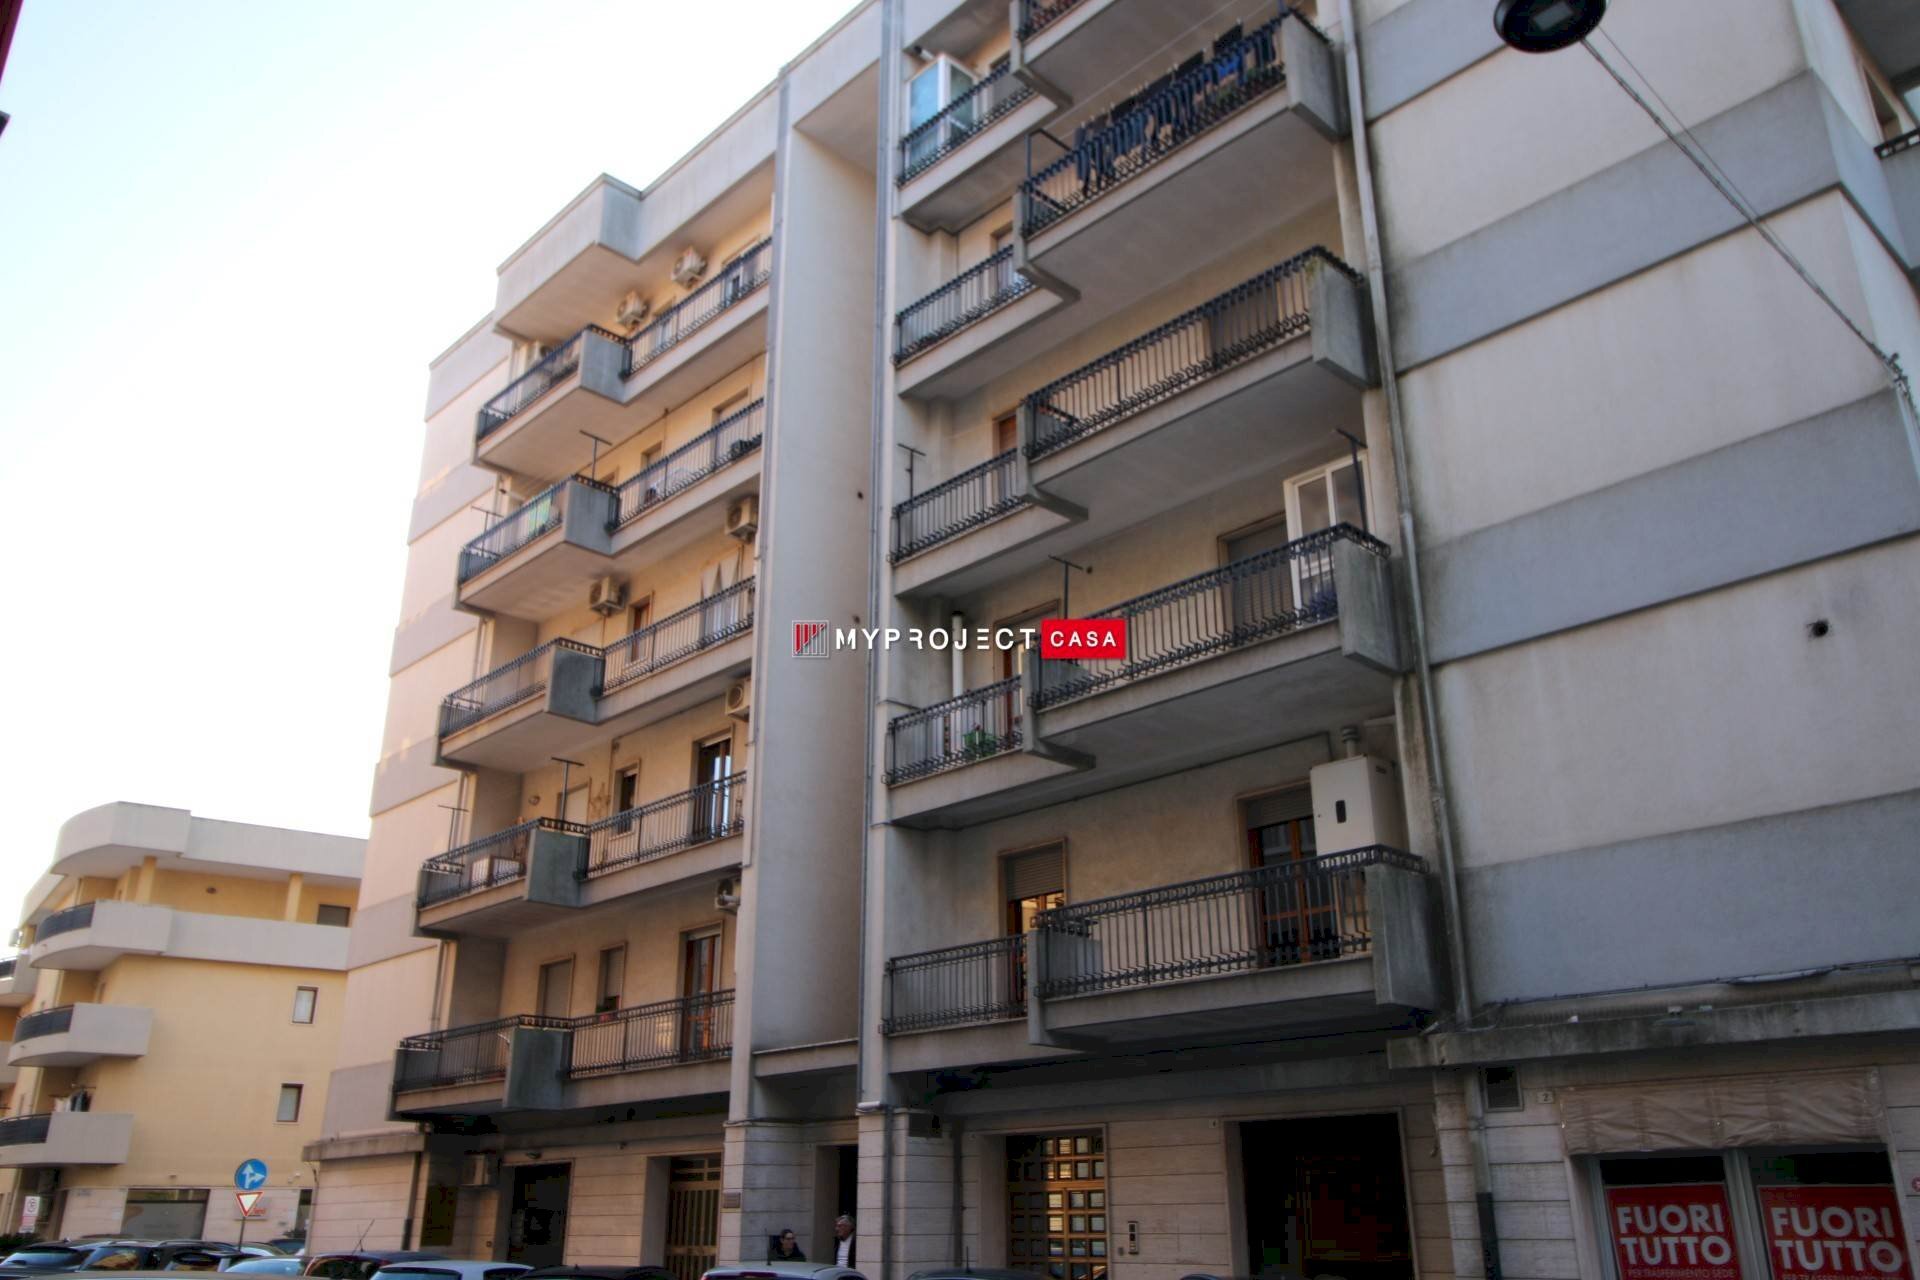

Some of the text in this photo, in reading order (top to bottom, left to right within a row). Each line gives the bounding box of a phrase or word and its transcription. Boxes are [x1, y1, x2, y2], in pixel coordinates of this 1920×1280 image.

[1616, 1204, 1725, 1233] FUORI
[1770, 1206, 1895, 1238] FUORI
[1620, 1235, 1732, 1265] TUTTO
[1774, 1239, 1903, 1273] TUTTO
